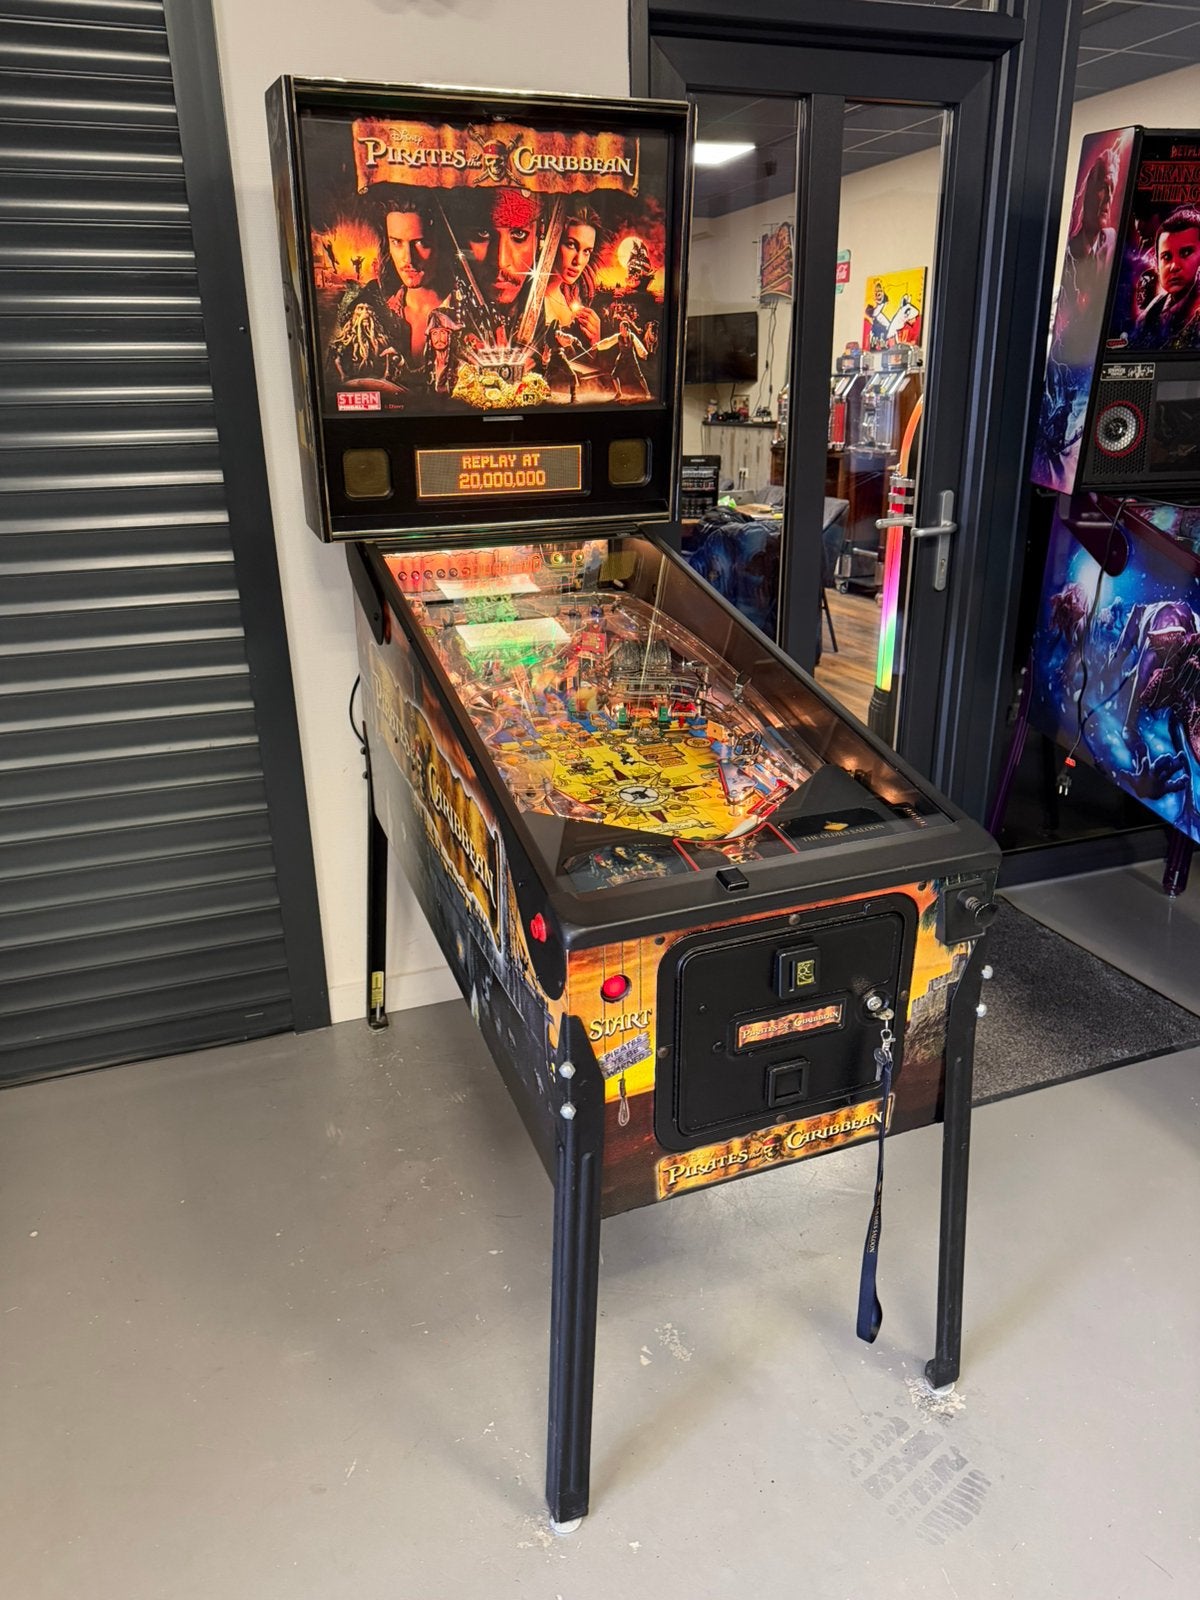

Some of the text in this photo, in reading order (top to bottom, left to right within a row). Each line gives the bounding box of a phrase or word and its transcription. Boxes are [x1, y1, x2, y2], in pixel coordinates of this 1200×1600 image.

[358, 137, 466, 168] PIRATES
[513, 146, 634, 176] CARIBBEAN
[1171, 145, 1200, 158] NETFL
[339, 393, 379, 405] STERN
[461, 454, 541, 469] REPLAY AT
[458, 470, 546, 490] 20,000,000
[428, 762, 497, 908] CARIBBEAN
[850, 823, 886, 835] SALOON
[588, 1009, 653, 1041] START
[604, 1036, 643, 1061] PIRATES
[606, 1053, 645, 1077] WARNED
[663, 1112, 883, 1186] PIRATES CARIBBEAN
